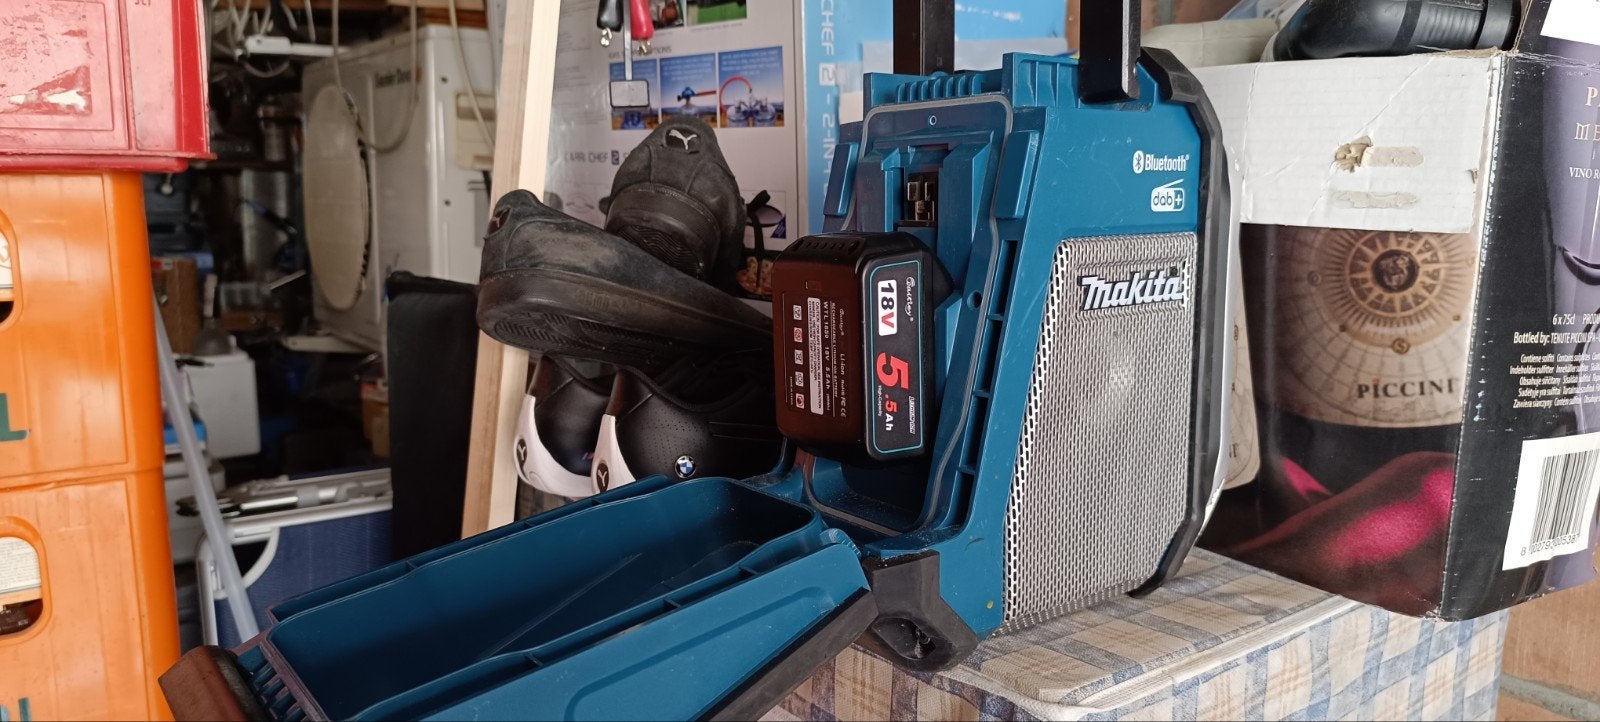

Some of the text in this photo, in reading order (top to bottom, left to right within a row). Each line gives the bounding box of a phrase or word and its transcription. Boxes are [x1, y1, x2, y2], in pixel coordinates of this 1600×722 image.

[820, 64, 836, 86] 2
[1585, 86, 1600, 107] P
[1145, 154, 1187, 171] Bluetooth
[1569, 166, 1600, 179] VINO R
[880, 282, 895, 329] 18V
[1513, 331, 1540, 344] Bottled
[1540, 331, 1551, 346] by:
